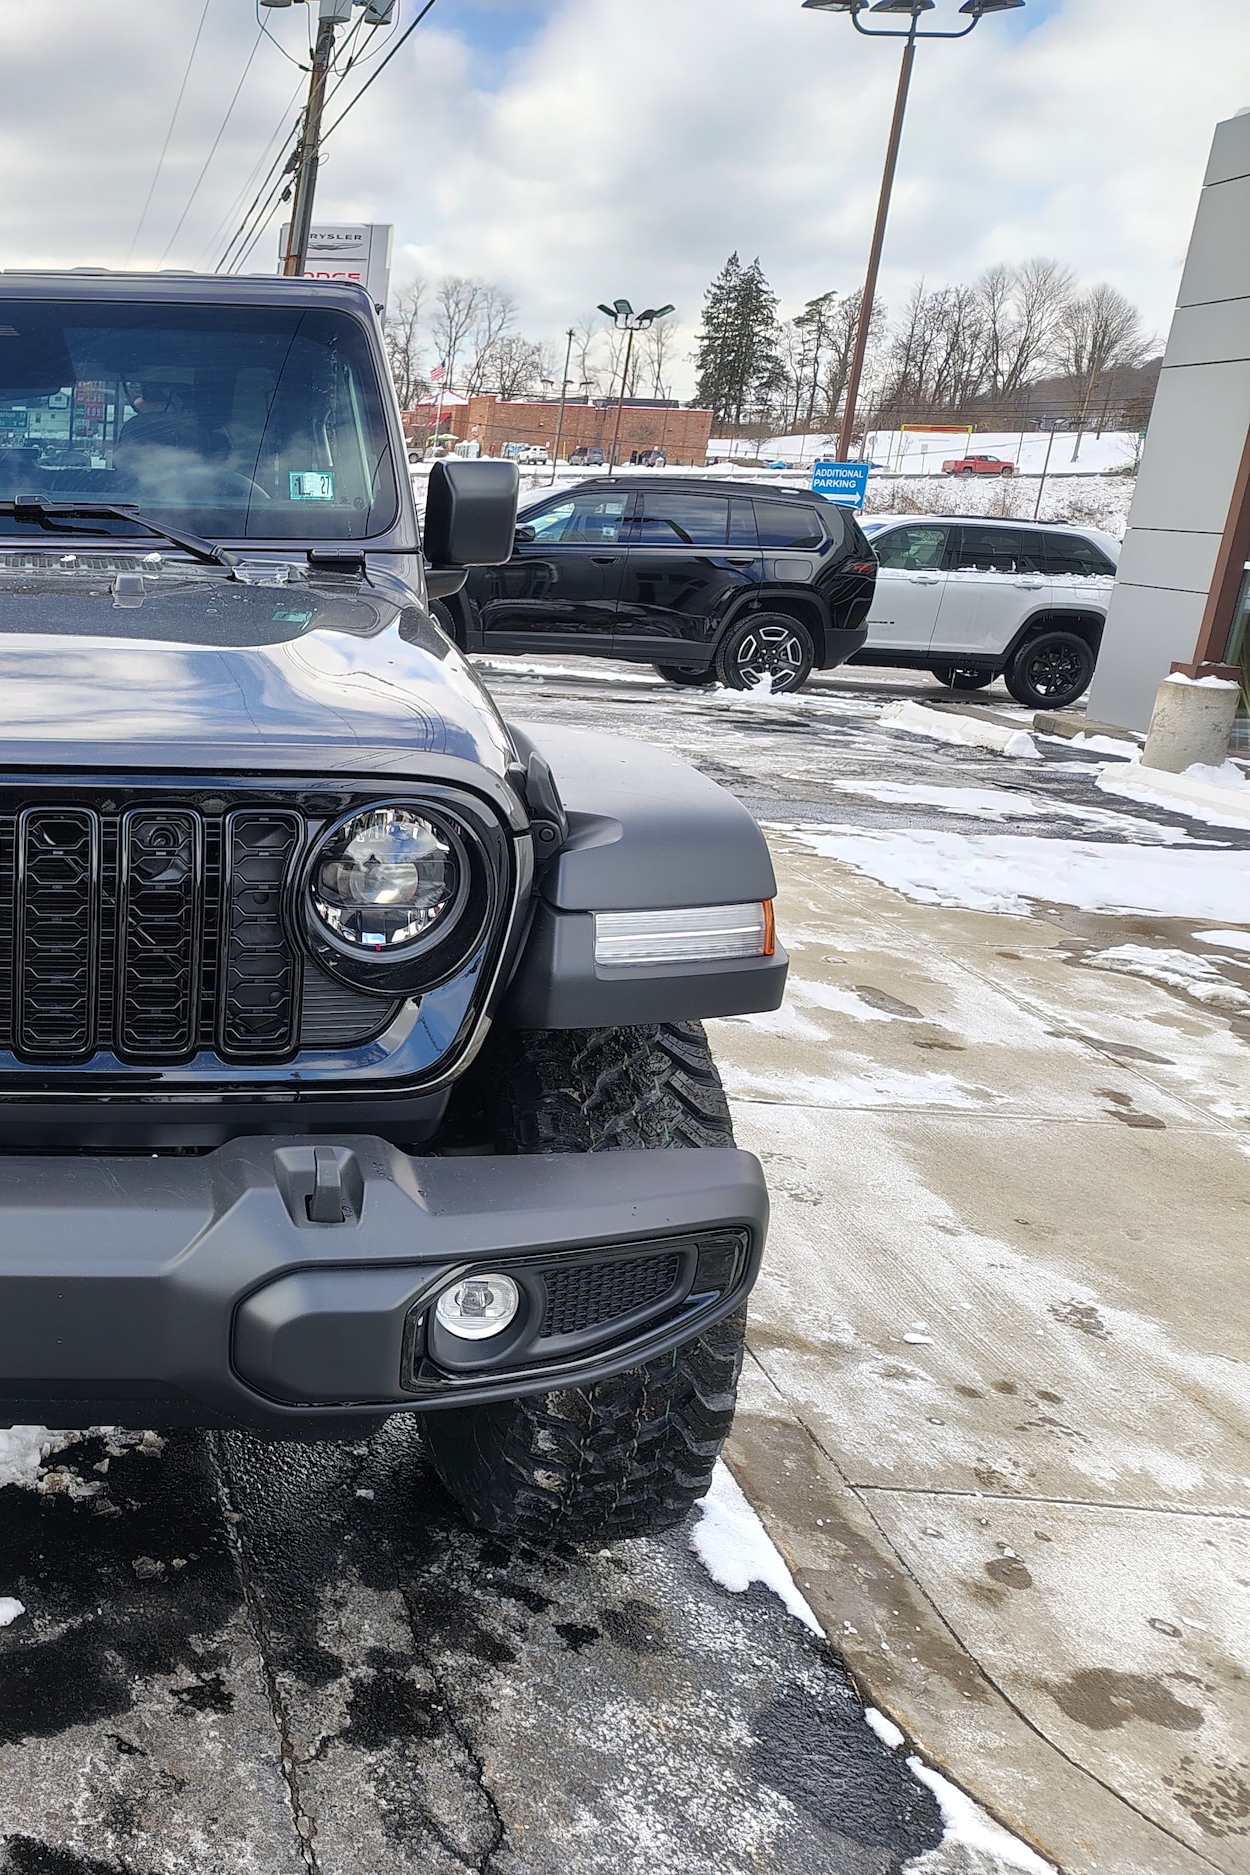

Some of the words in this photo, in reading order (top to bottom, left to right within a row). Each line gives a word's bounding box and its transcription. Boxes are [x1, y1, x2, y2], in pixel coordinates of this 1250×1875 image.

[310, 233, 363, 241] RYSLER
[815, 469, 864, 478] ADDITIONAL
[320, 476, 330, 495] 27
[813, 479, 857, 488] PARKING
